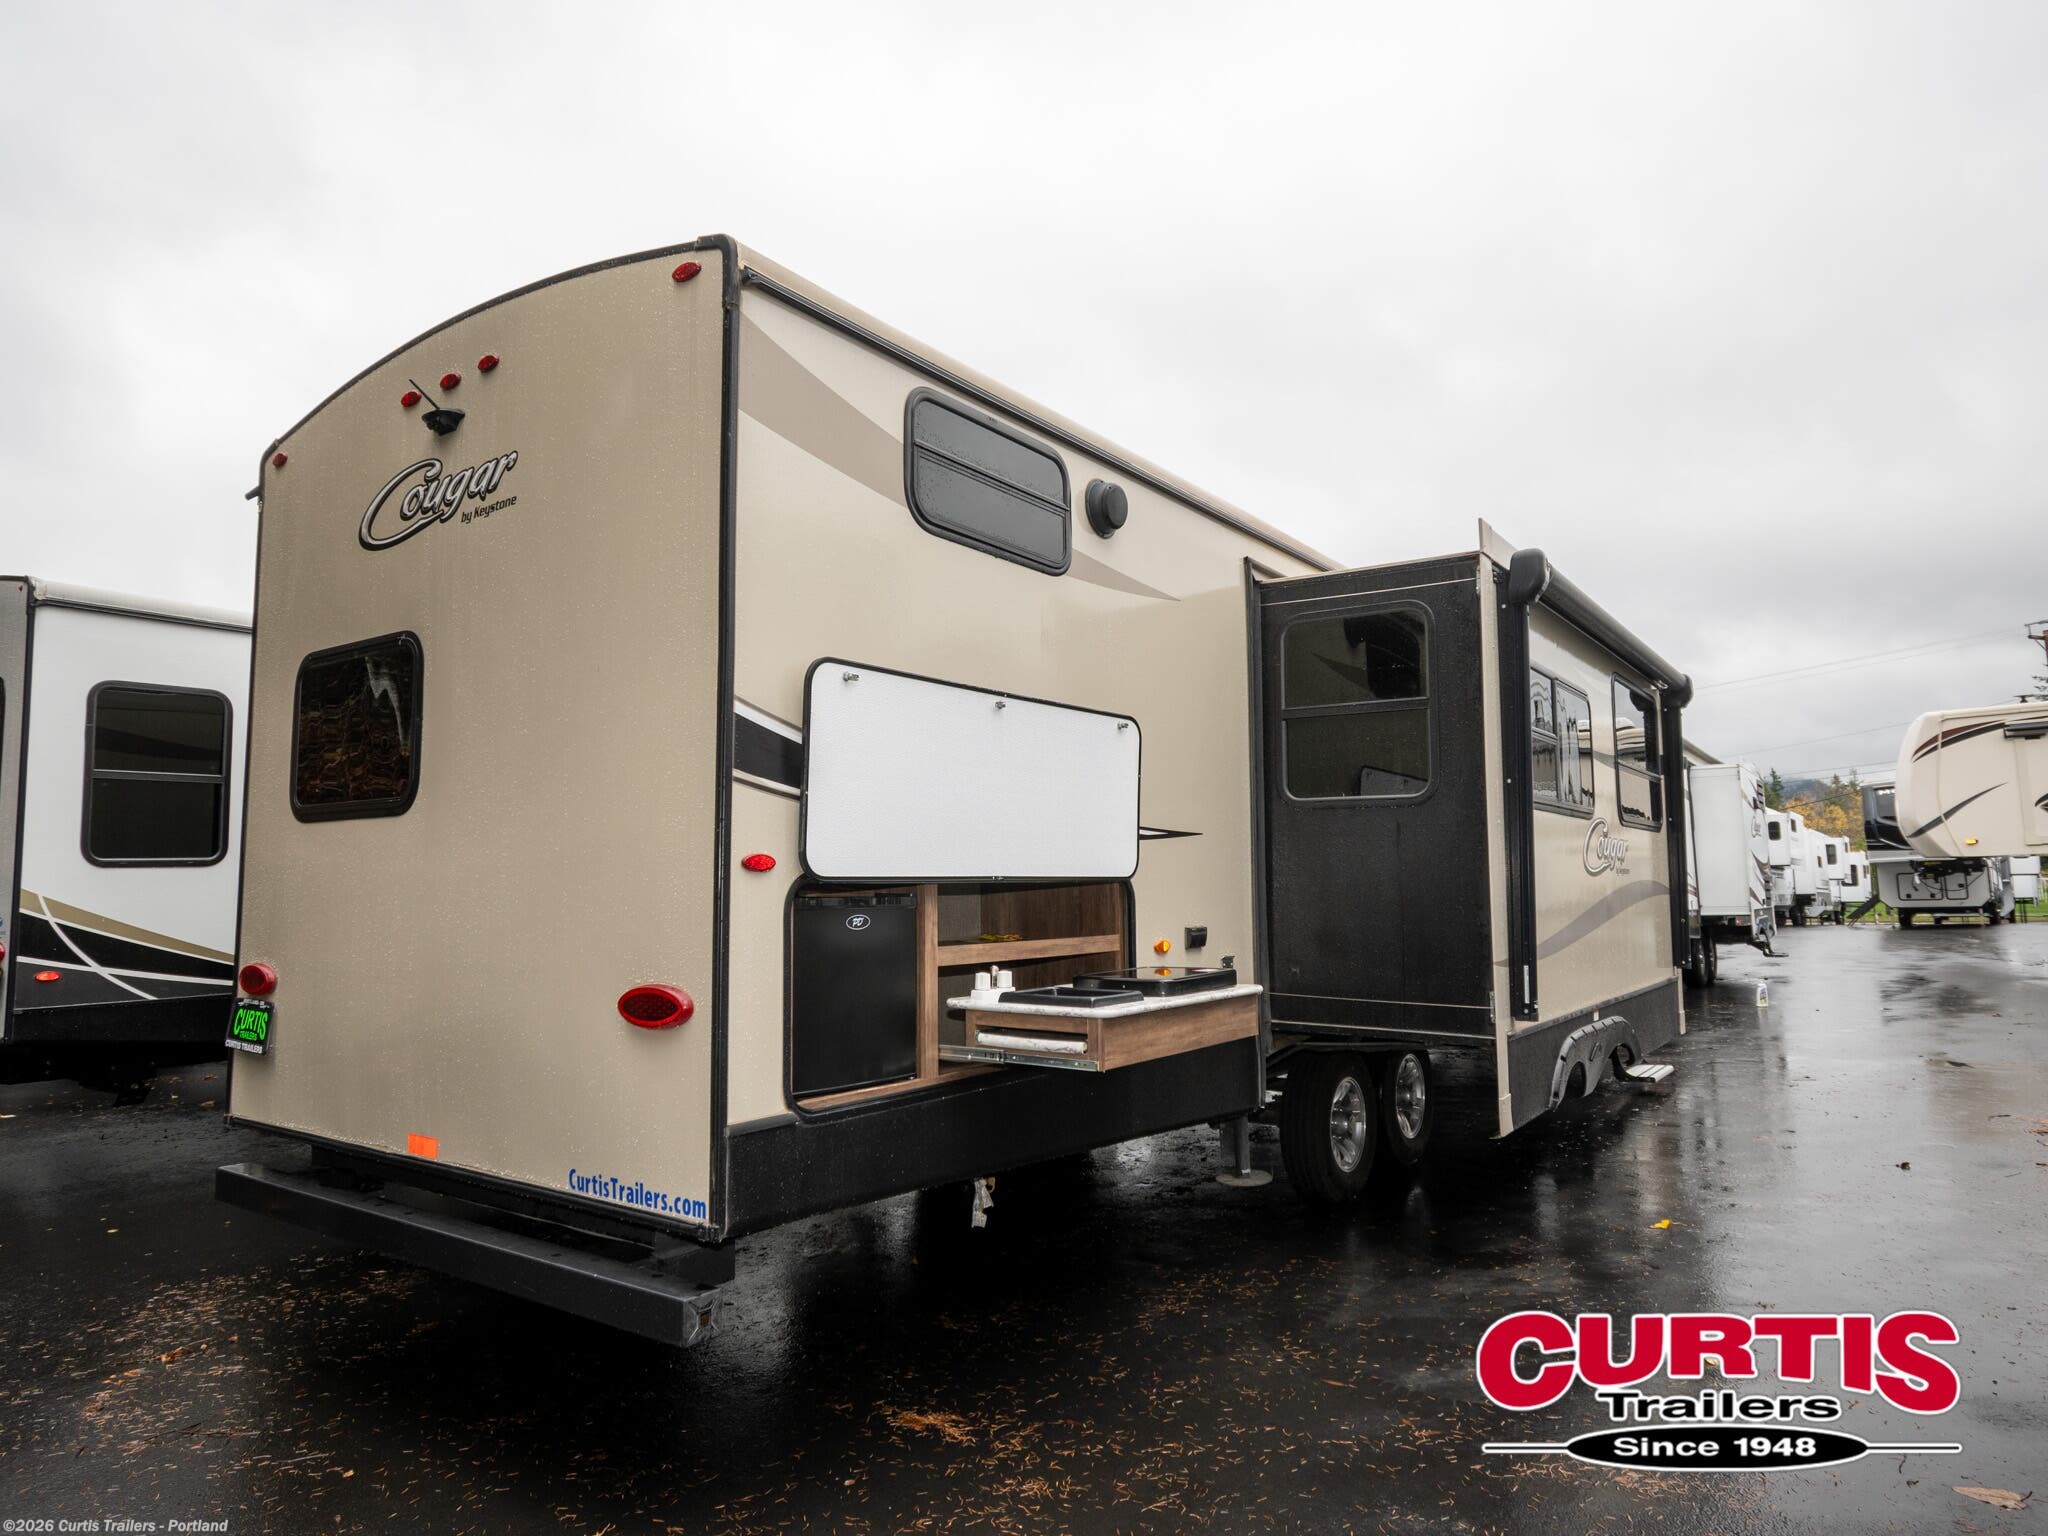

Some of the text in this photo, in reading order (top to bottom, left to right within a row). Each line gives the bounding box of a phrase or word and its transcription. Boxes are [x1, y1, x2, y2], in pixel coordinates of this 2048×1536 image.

[359, 450, 518, 551] Cougar
[461, 496, 517, 524] by Keystone
[233, 1008, 268, 1041] CURTIS
[569, 1168, 706, 1220] CurtisTrailers.com
